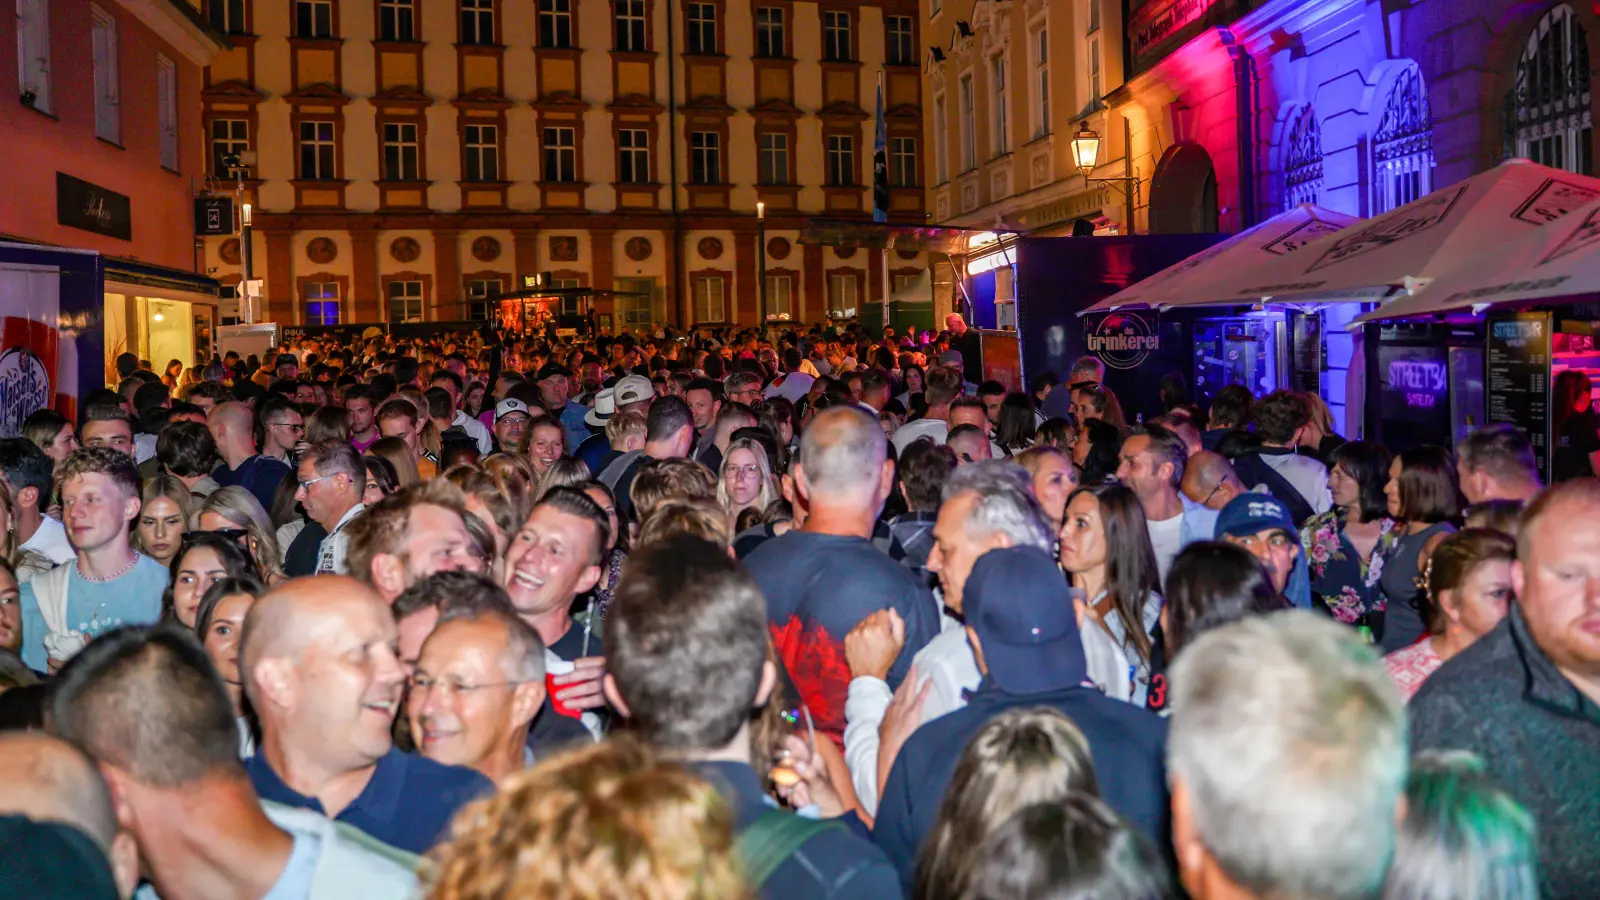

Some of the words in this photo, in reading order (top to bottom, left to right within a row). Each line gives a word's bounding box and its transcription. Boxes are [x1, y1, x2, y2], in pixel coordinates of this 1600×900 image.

[1087, 333, 1159, 350] trinkerei
[1389, 361, 1447, 391] STREETBA
[1149, 673, 1167, 707] 3
